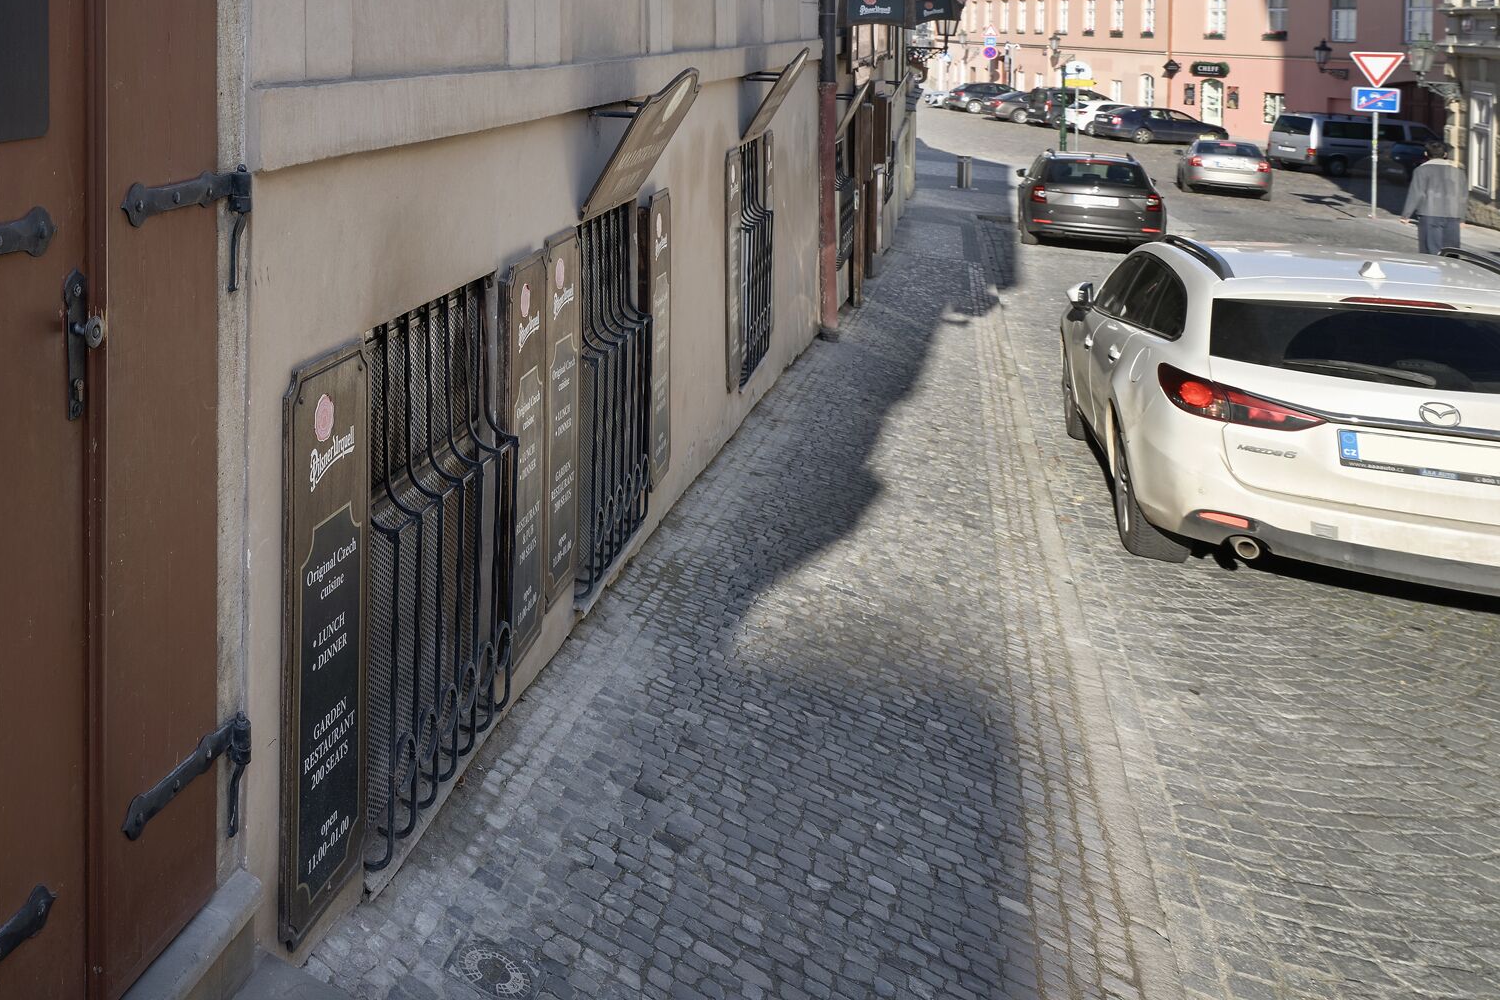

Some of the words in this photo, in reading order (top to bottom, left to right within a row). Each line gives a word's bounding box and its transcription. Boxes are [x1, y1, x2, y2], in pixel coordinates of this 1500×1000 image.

[309, 445, 334, 493] Pilsner
[333, 425, 355, 459] Urquell
[1343, 448, 1357, 457] CZ
[306, 552, 336, 588] Original
[337, 537, 357, 563] Czech
[320, 572, 345, 600] cuisine
[318, 611, 346, 648] LUNCH
[317, 632, 348, 671] DINNER
[313, 696, 348, 741] GARDEN
[303, 709, 356, 776] RESTAURANT
[310, 765, 326, 791] 200
[325, 739, 349, 775] SEATS
[320, 809, 338, 837] open
